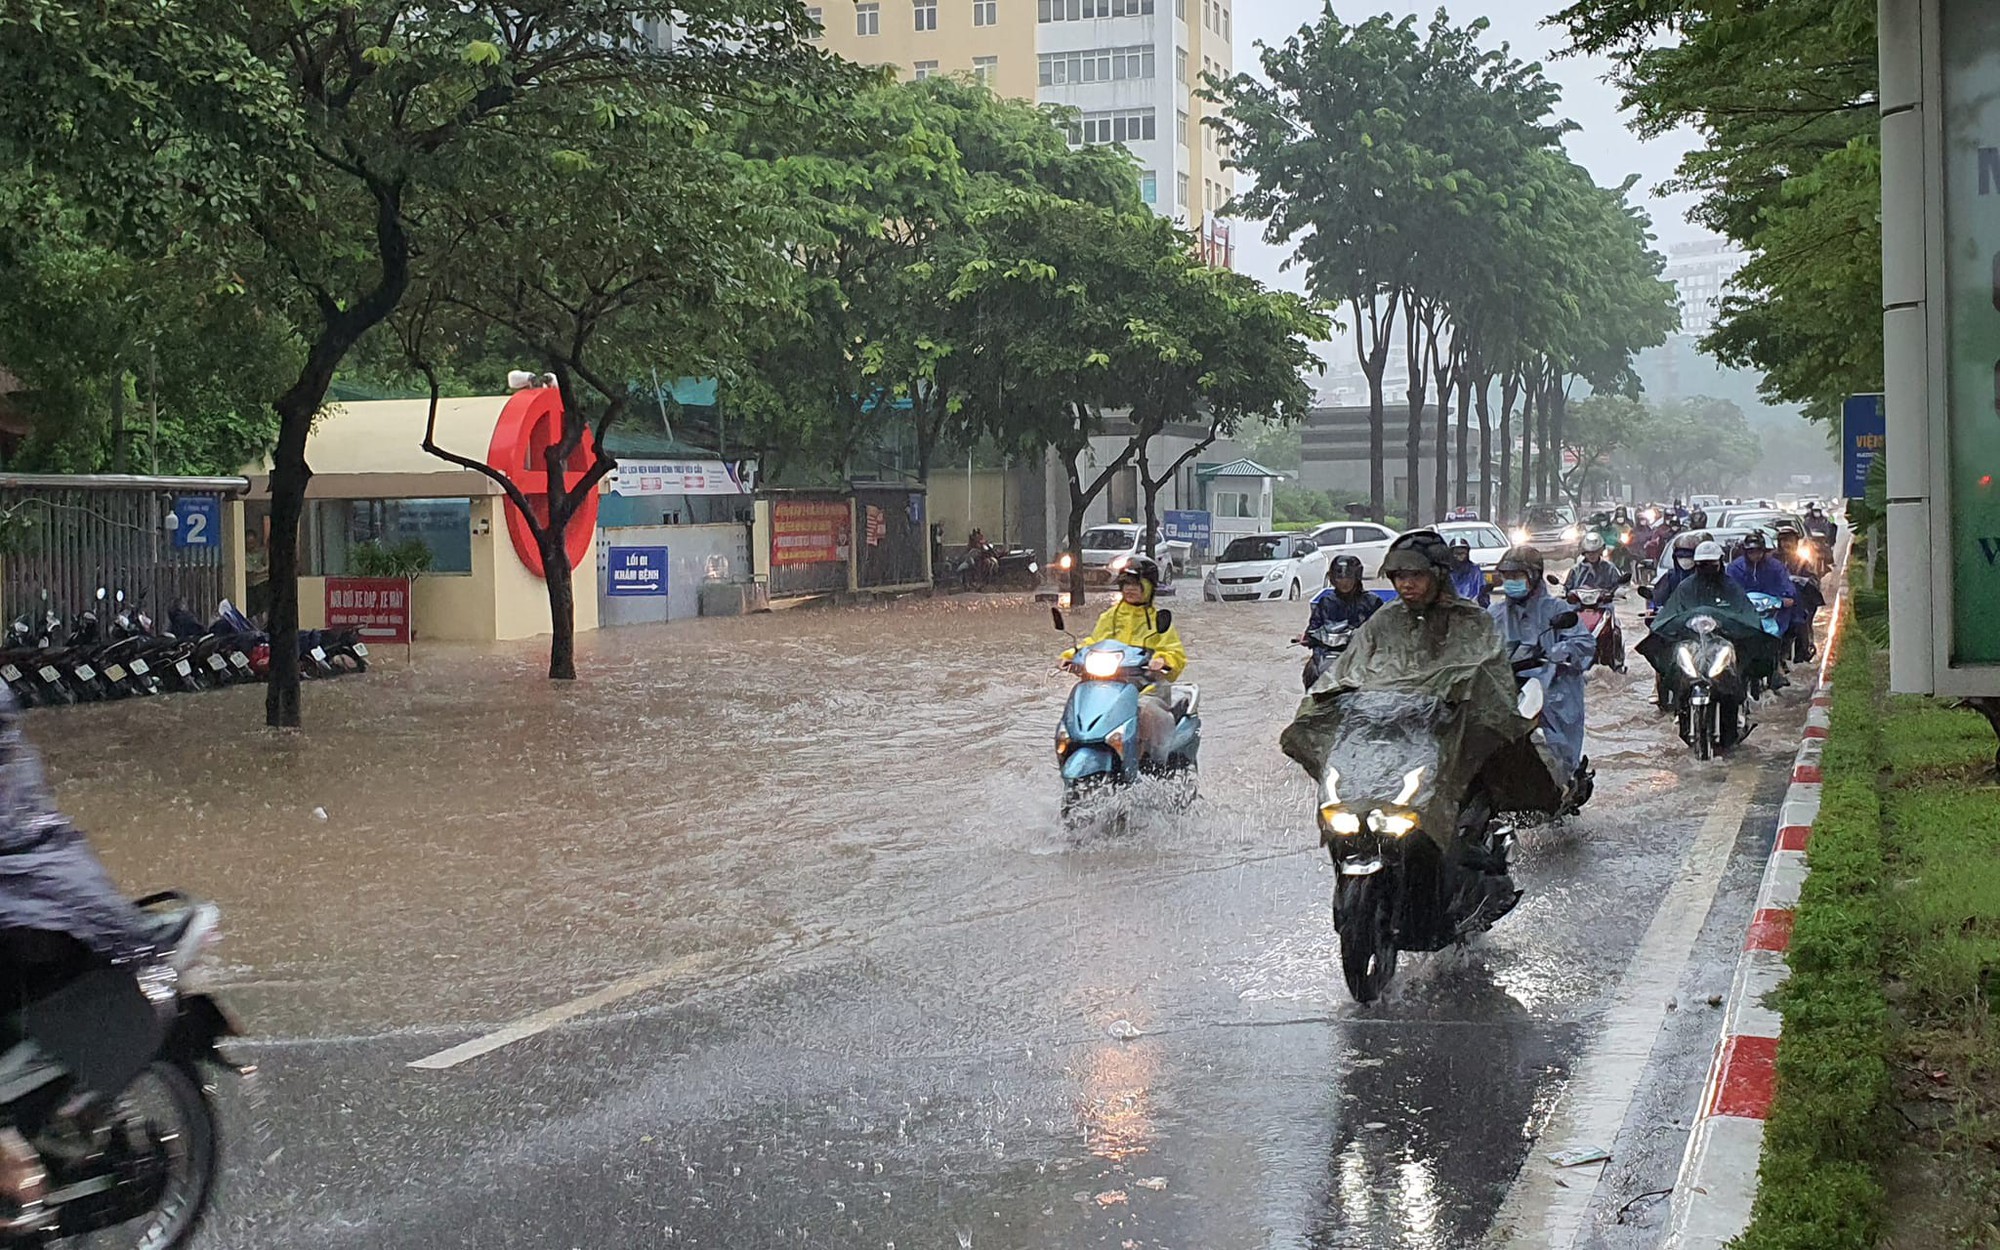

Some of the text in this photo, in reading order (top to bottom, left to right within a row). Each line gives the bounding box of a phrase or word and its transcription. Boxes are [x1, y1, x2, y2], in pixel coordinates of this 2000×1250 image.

[186, 513, 207, 543] 2
[626, 552, 639, 566] LỐI
[614, 568, 659, 582] KHÁM BỆNH
